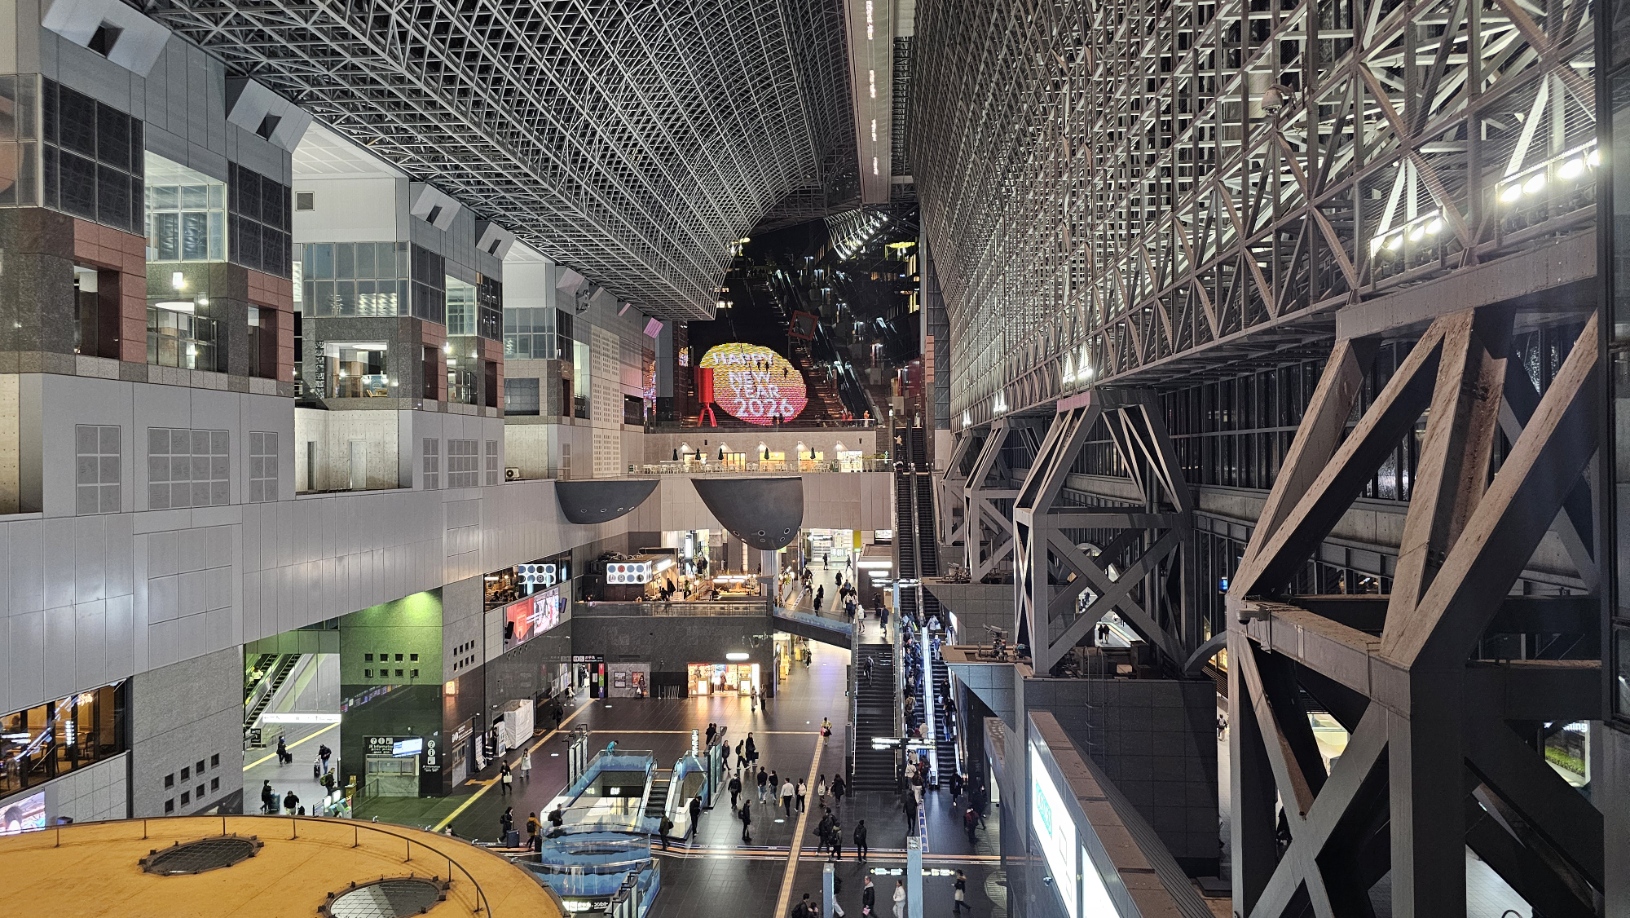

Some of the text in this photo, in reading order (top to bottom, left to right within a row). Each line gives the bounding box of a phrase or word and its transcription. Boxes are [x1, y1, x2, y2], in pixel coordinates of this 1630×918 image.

[712, 352, 774, 365] HAPPY
[728, 371, 771, 385] NEW
[731, 385, 780, 398] YEAR
[734, 399, 794, 417] 2026
